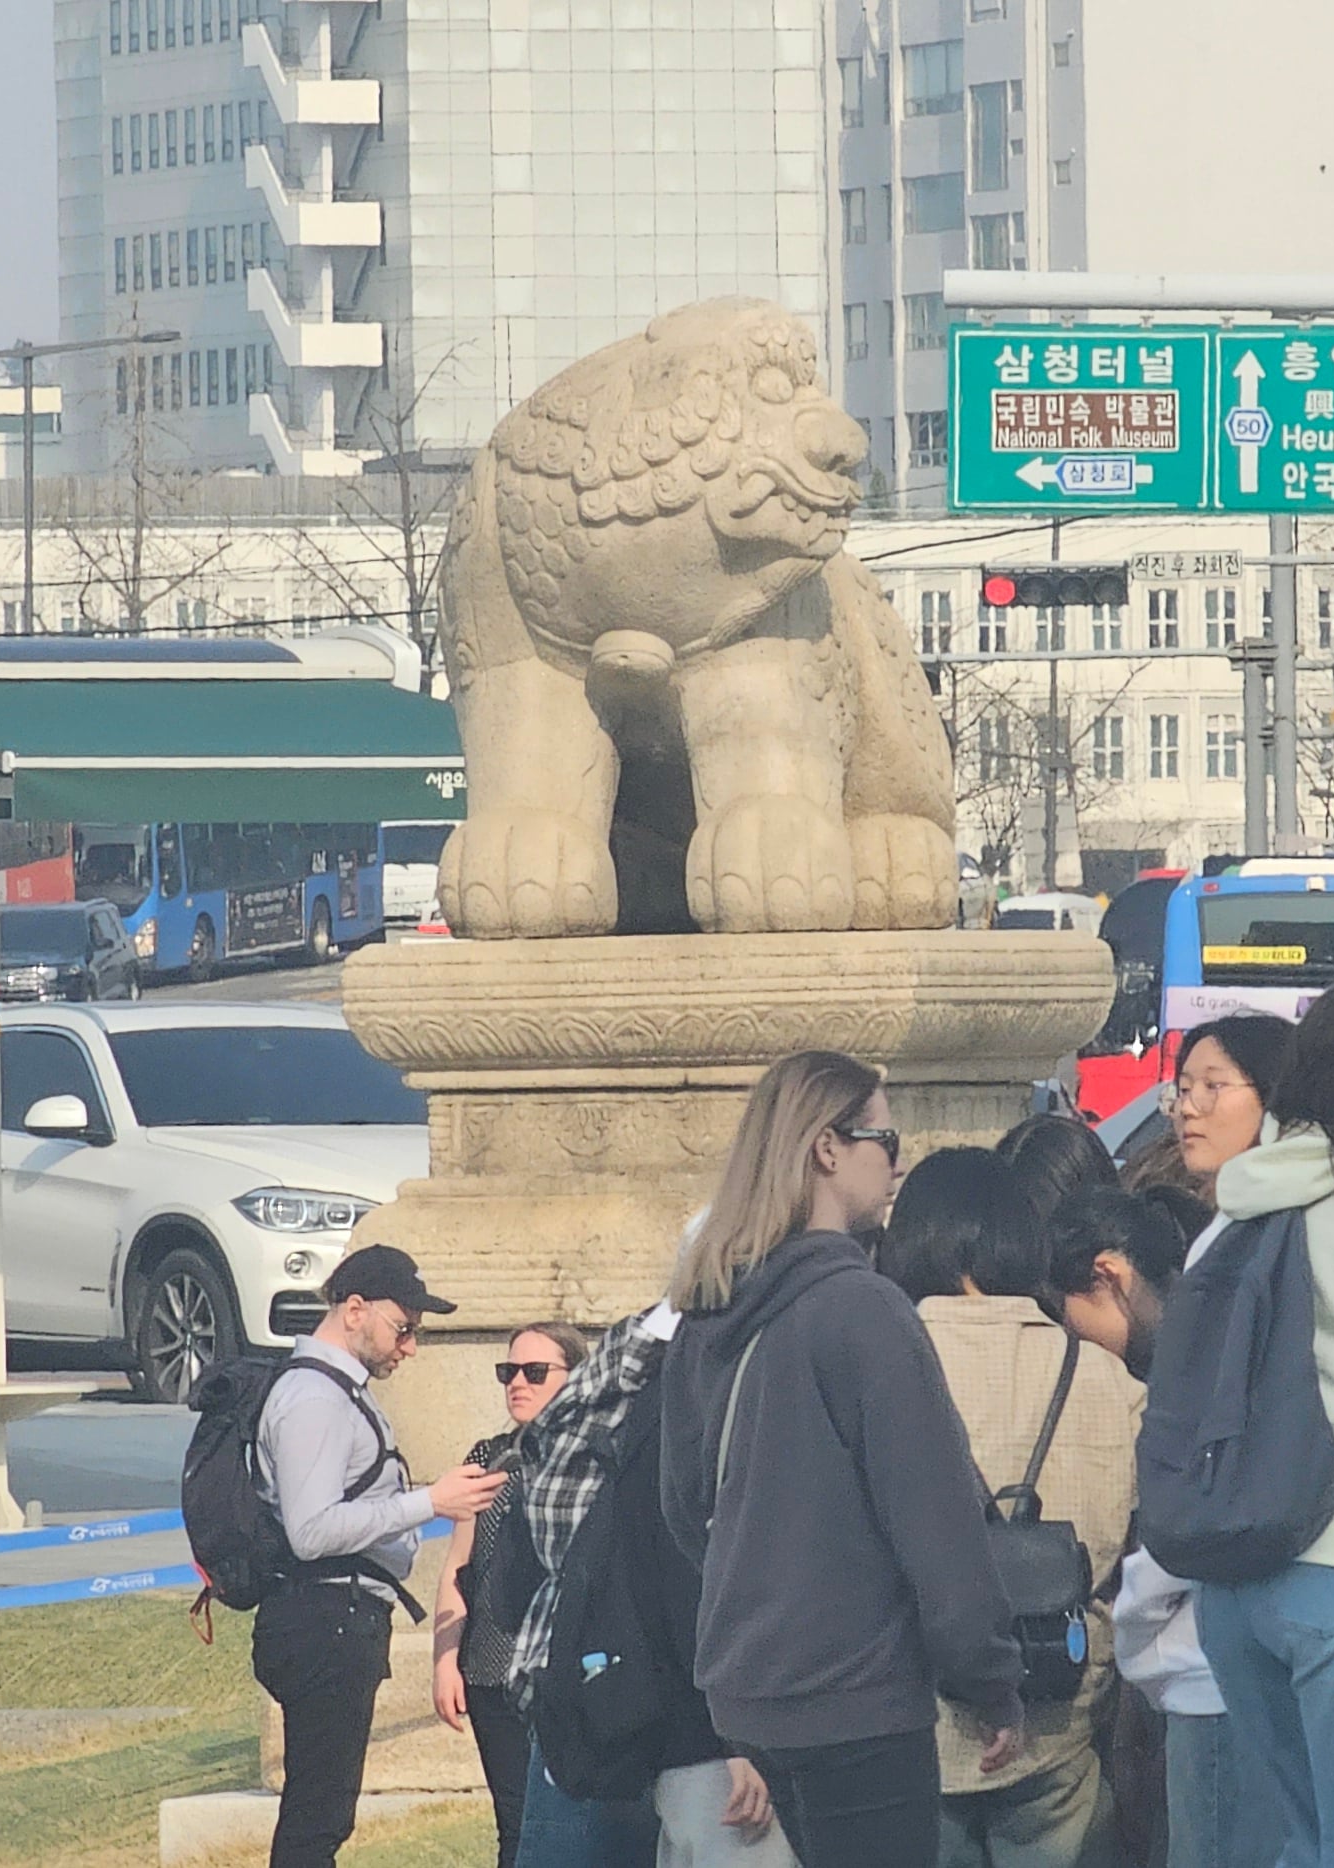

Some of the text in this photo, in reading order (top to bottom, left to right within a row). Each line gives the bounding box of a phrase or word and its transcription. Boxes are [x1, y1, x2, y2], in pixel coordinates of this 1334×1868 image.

[994, 344, 1174, 384] 삼청터널
[997, 395, 1173, 426] 국립민속 박물관
[997, 425, 1174, 448] National Folk Museum
[1237, 418, 1260, 435] 50
[1069, 465, 1127, 483] 삼청로
[1136, 553, 1239, 577] 직진 후 좌회전
[1190, 996, 1205, 1008] LG
